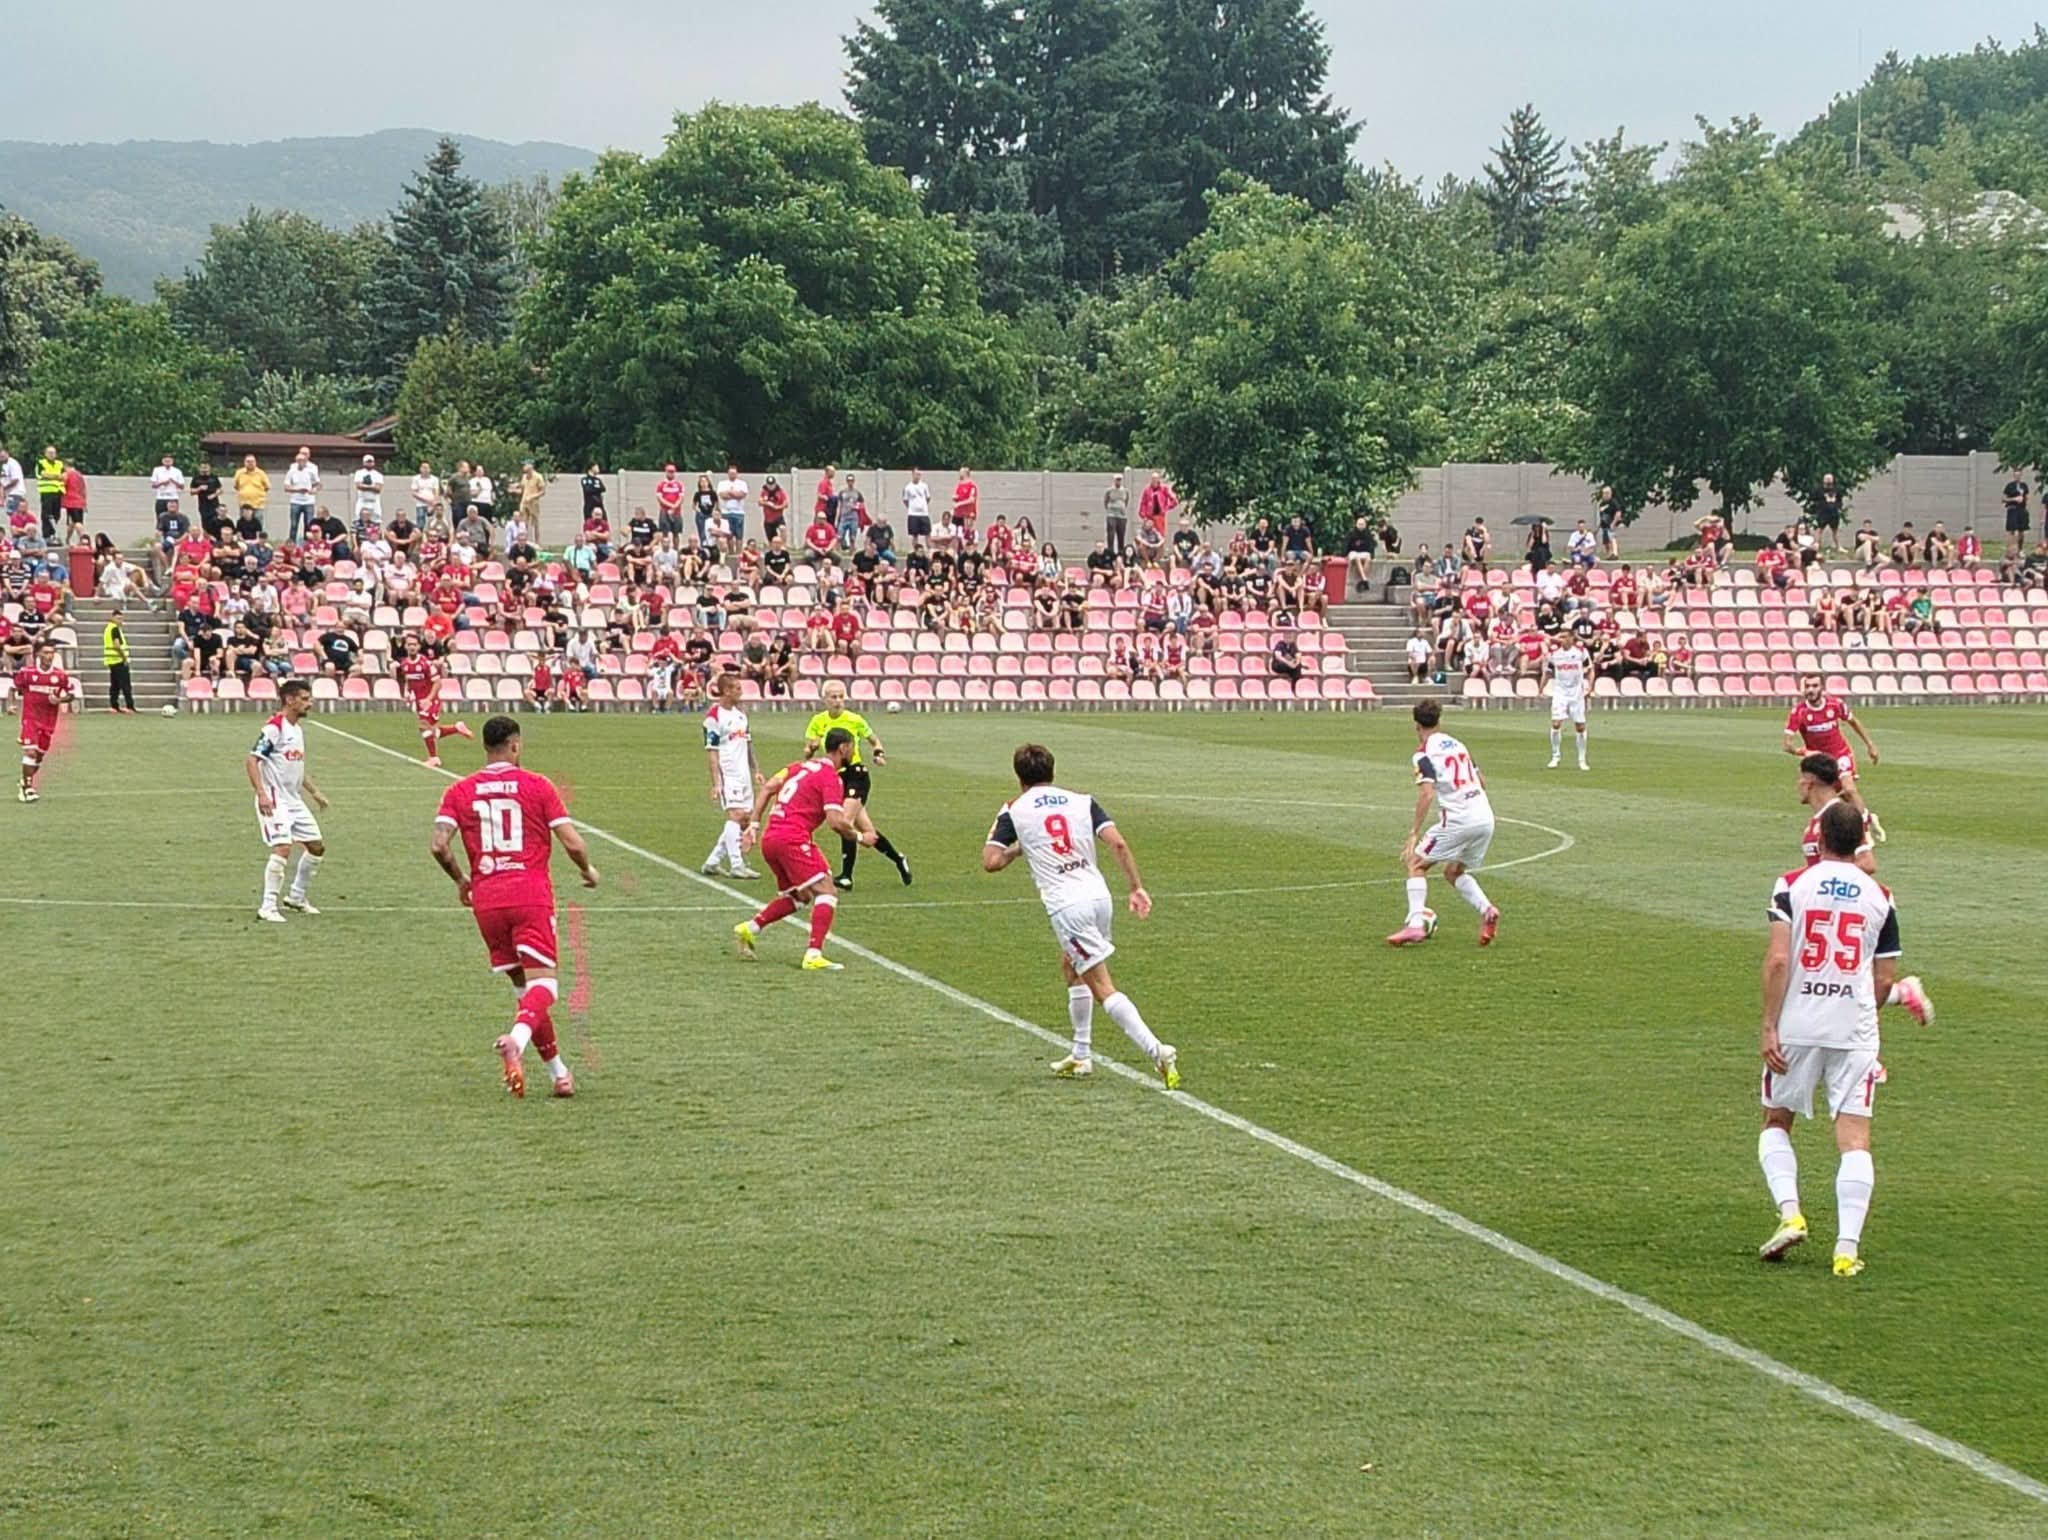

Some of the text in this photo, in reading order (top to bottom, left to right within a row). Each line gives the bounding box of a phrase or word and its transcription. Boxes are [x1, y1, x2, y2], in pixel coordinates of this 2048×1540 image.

[472, 798, 524, 853] 10
[1044, 814, 1072, 854] 9
[1801, 910, 1867, 971] 55
[1801, 981, 1854, 999] ЗОРА
